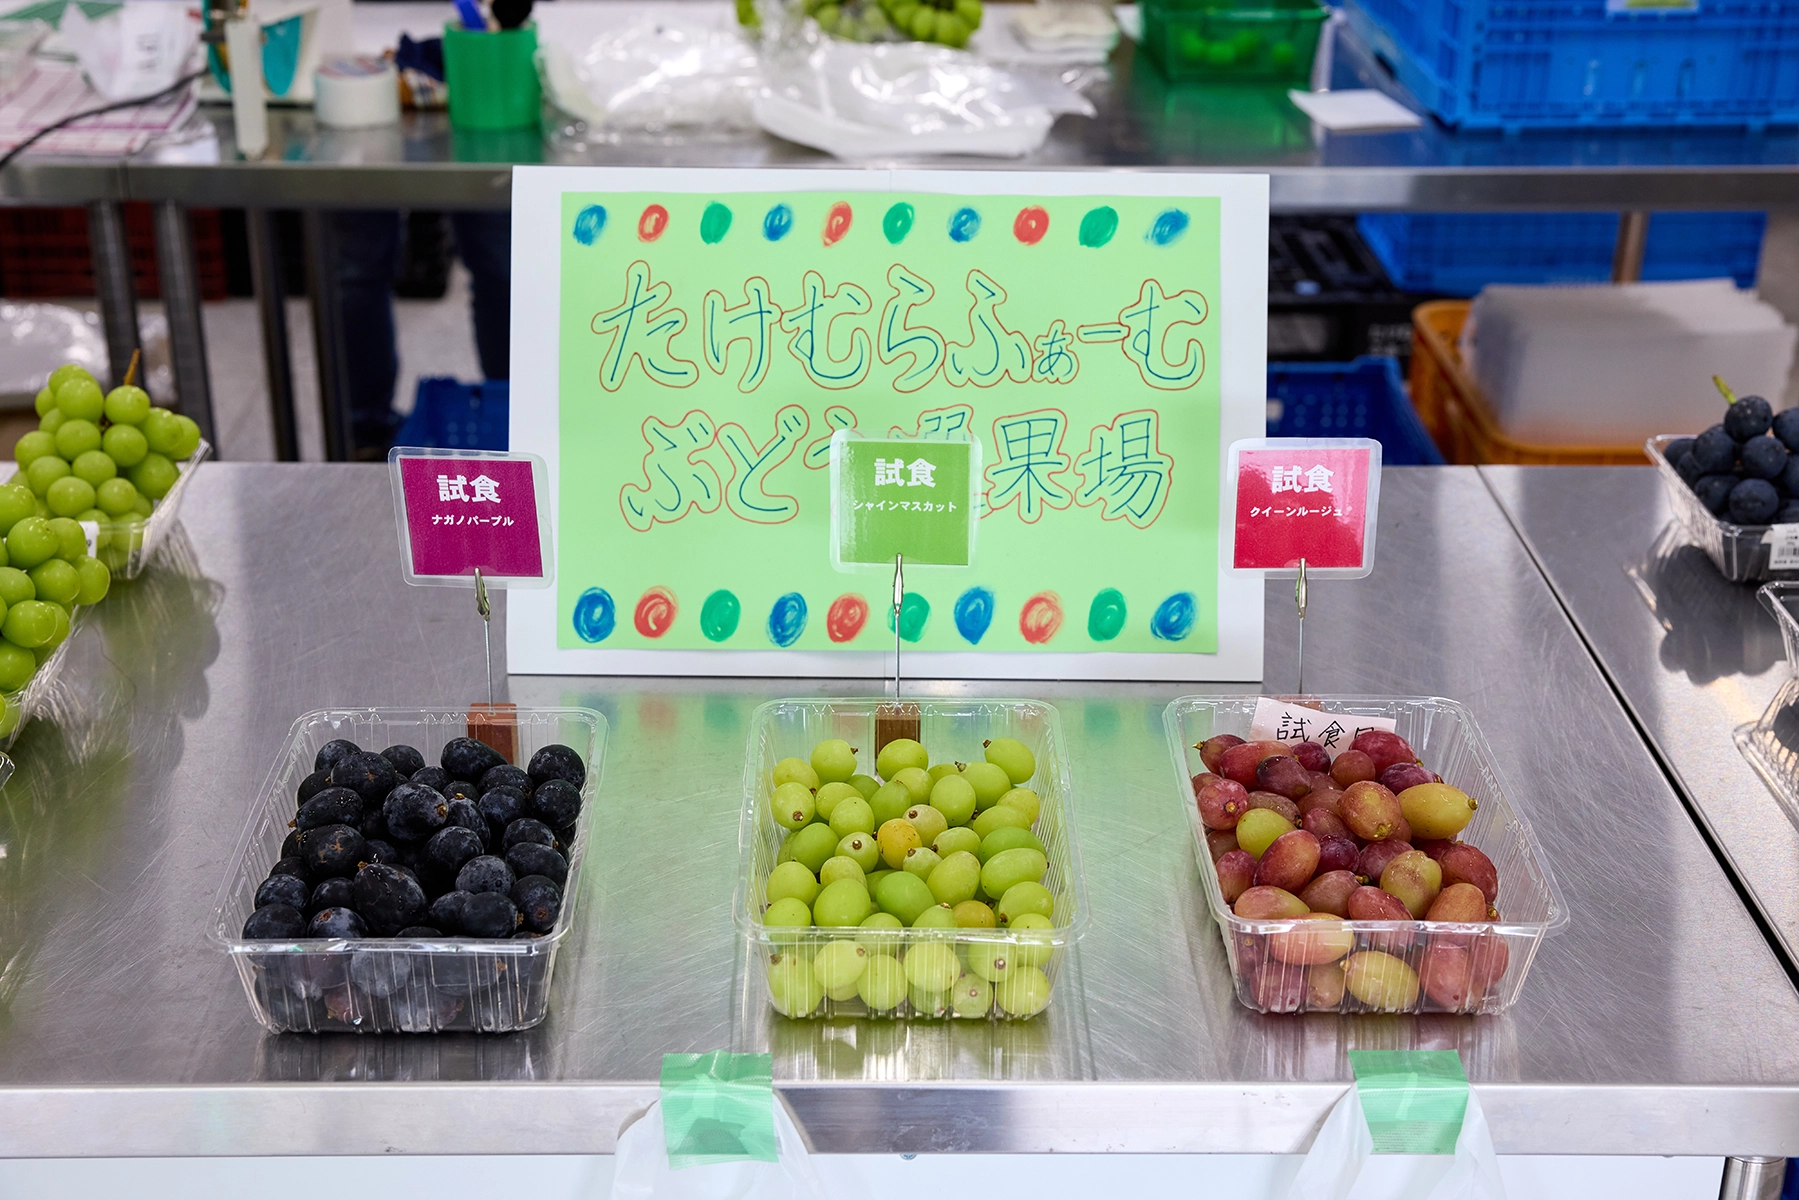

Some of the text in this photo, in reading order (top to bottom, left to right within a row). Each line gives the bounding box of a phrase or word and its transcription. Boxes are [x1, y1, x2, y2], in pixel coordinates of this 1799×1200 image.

[591, 260, 1208, 393] たけむらふぁーむ
[874, 458, 937, 488] 試食
[1271, 464, 1335, 494] 試食
[437, 474, 502, 503] 試食
[431, 514, 515, 527] ナガノパープル
[852, 500, 957, 513] シャインマスカット
